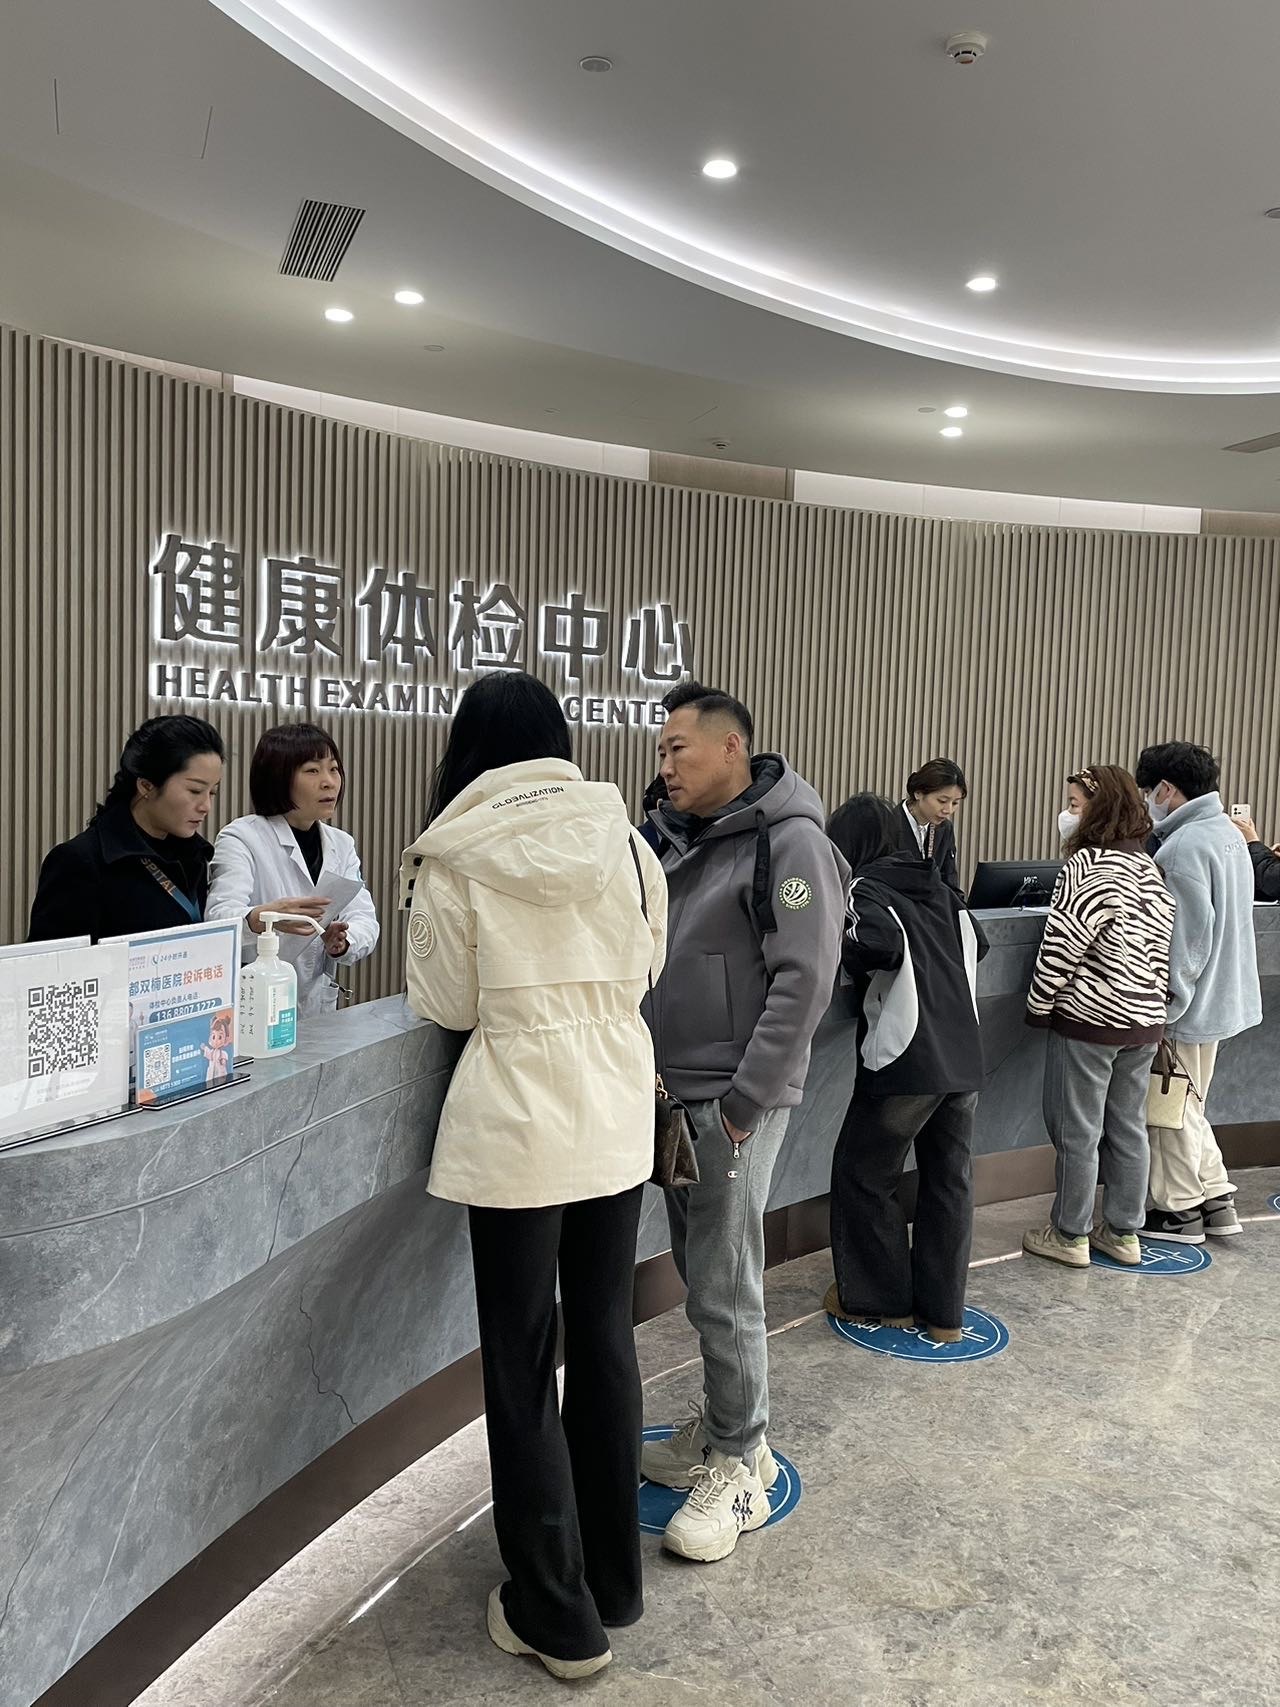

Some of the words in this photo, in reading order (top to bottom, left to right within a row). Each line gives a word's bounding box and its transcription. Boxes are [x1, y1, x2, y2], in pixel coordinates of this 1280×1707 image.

[154, 533, 694, 682] 健康体检中心
[156, 664, 309, 706] HEALTH
[319, 678, 456, 715] EXAMIN
[562, 696, 666, 725] CENTE
[140, 857, 178, 896] SPITAL
[129, 964, 225, 997] 都双楠医院投诉电话
